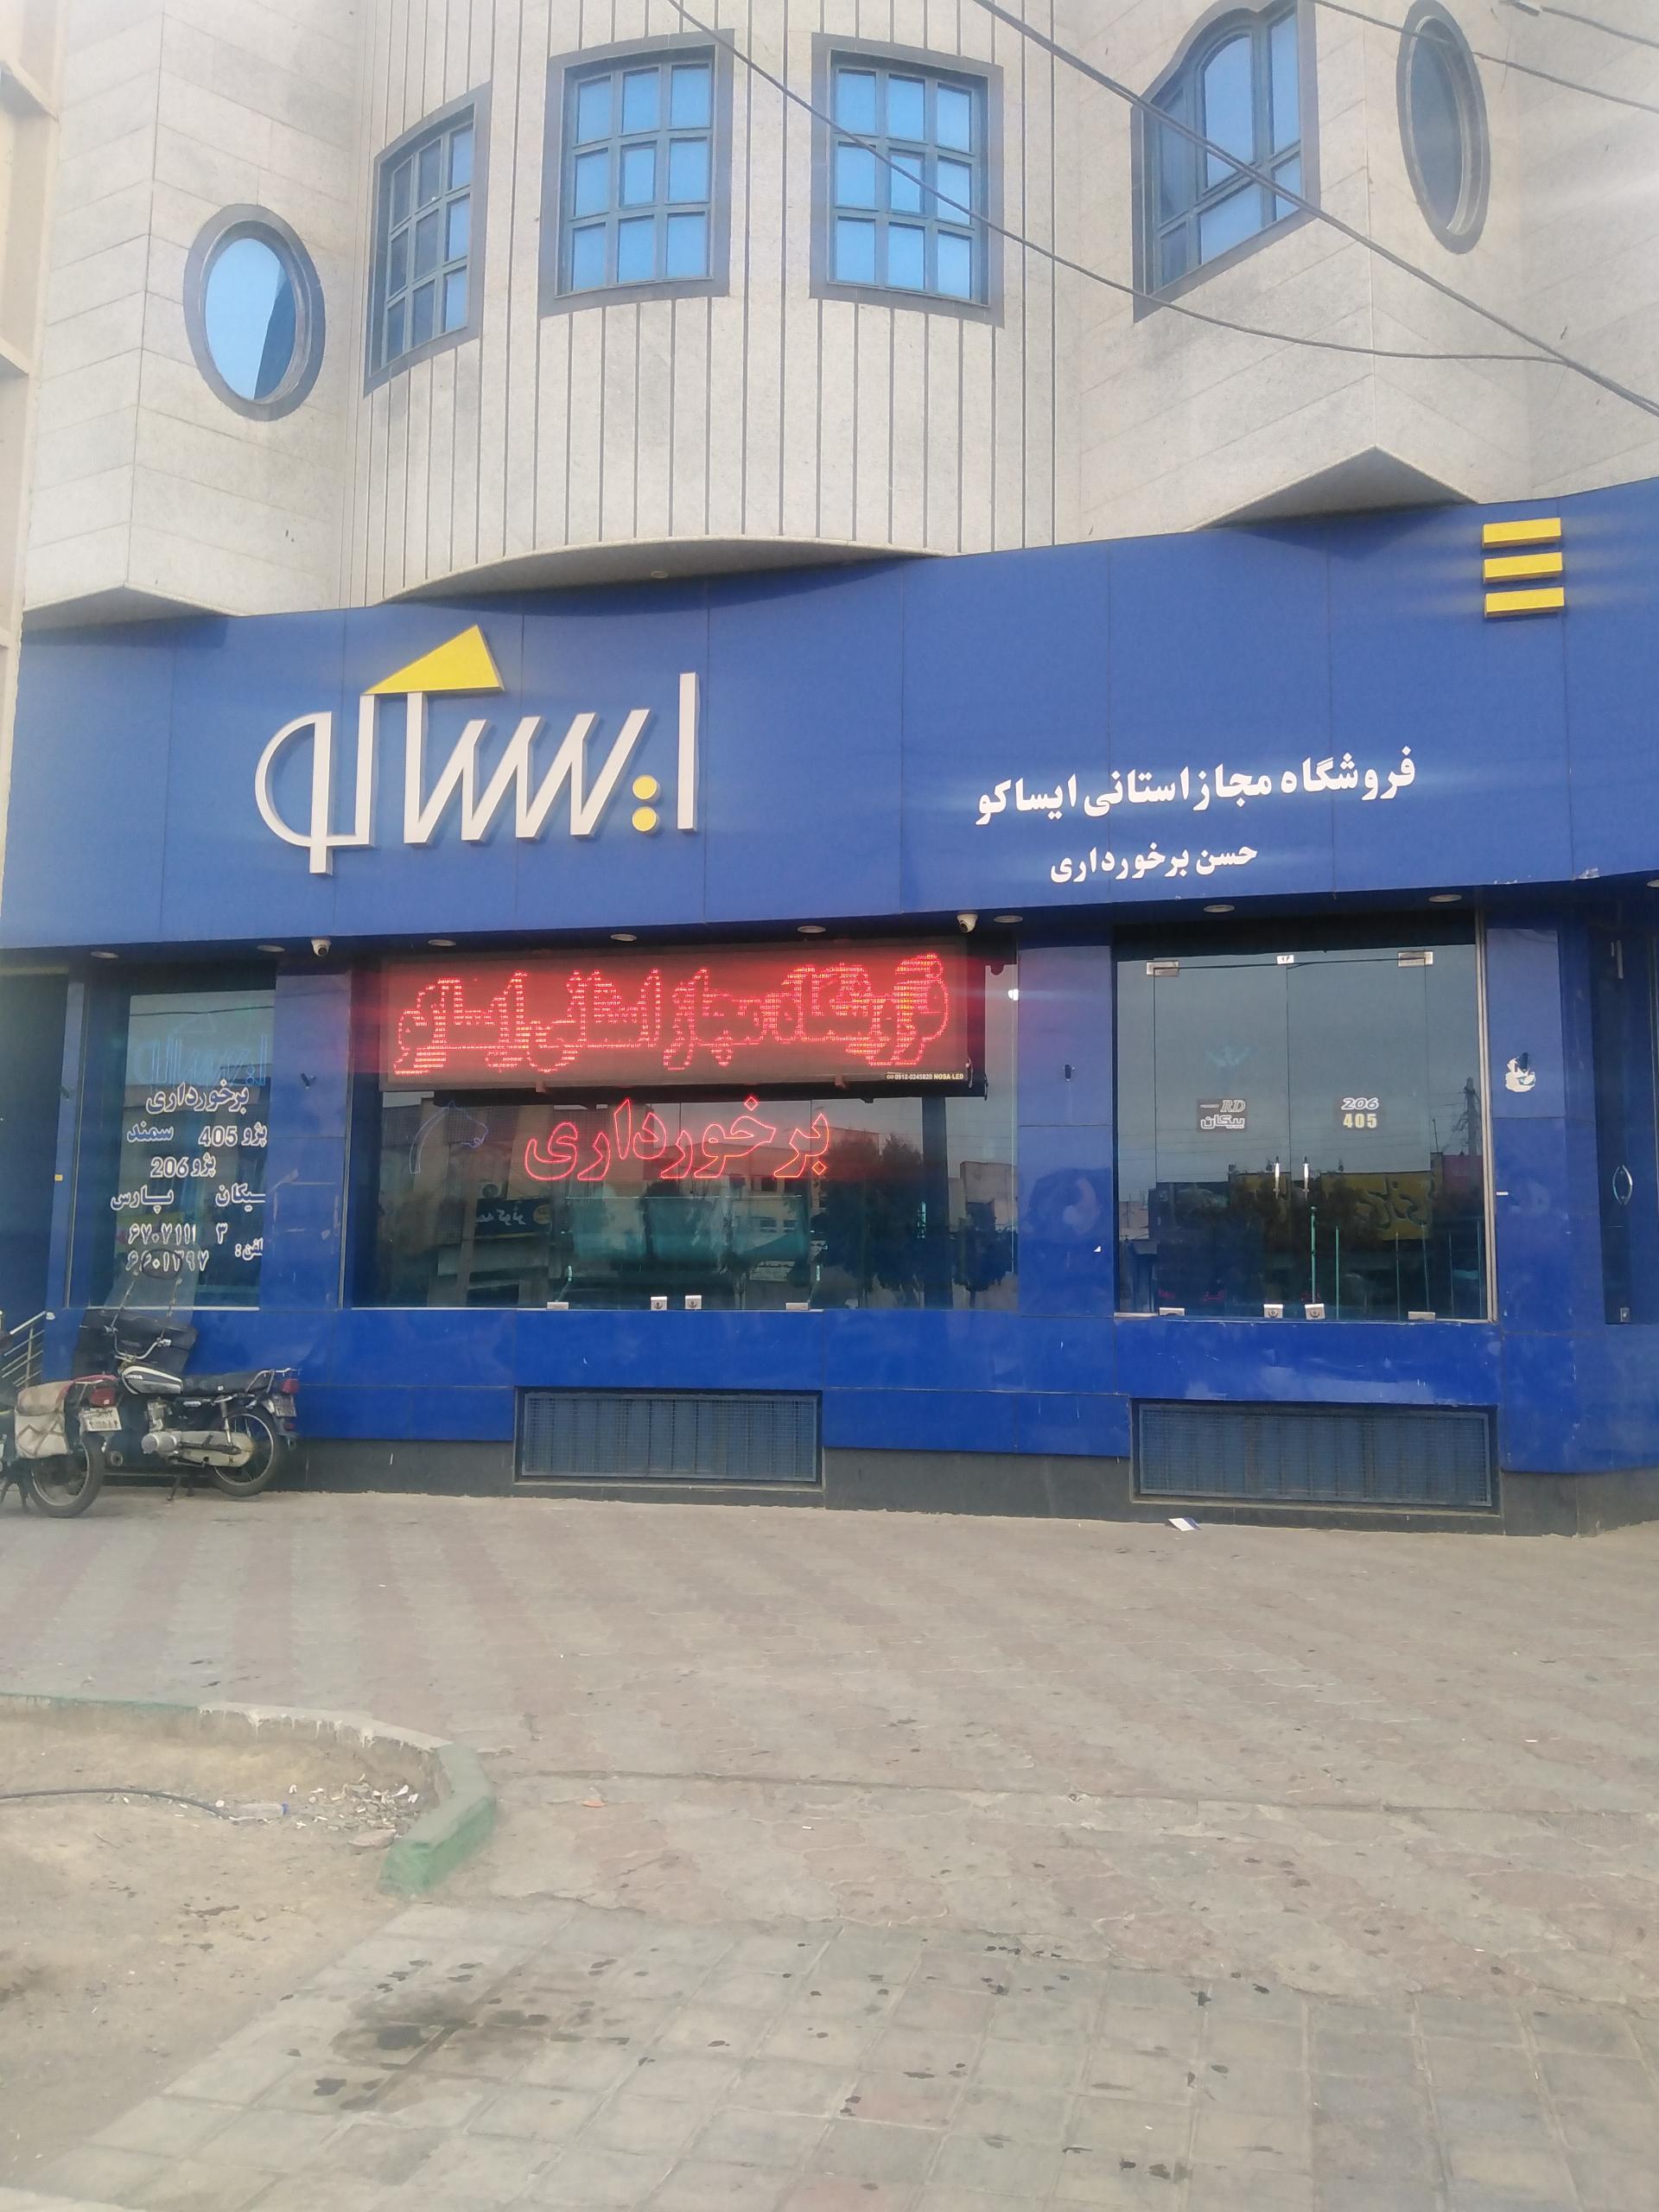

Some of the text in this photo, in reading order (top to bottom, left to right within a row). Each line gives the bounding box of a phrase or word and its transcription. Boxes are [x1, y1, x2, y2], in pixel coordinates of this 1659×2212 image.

[976, 746, 1415, 825] فروشگاه مجاز استانی ایساکو
[1050, 842, 1258, 883] حسن برخورداری
[146, 1079, 249, 1114] برخورداری
[1220, 1099, 1246, 1113] RD
[1341, 1097, 1379, 1110] 206
[127, 1121, 174, 1143] سمند
[1343, 1113, 1377, 1128] 405
[198, 1122, 267, 1147] پژو 405
[524, 1095, 830, 1180] برخورداری
[150, 1152, 217, 1178] پژو 206
[215, 1183, 266, 1211] یکان
